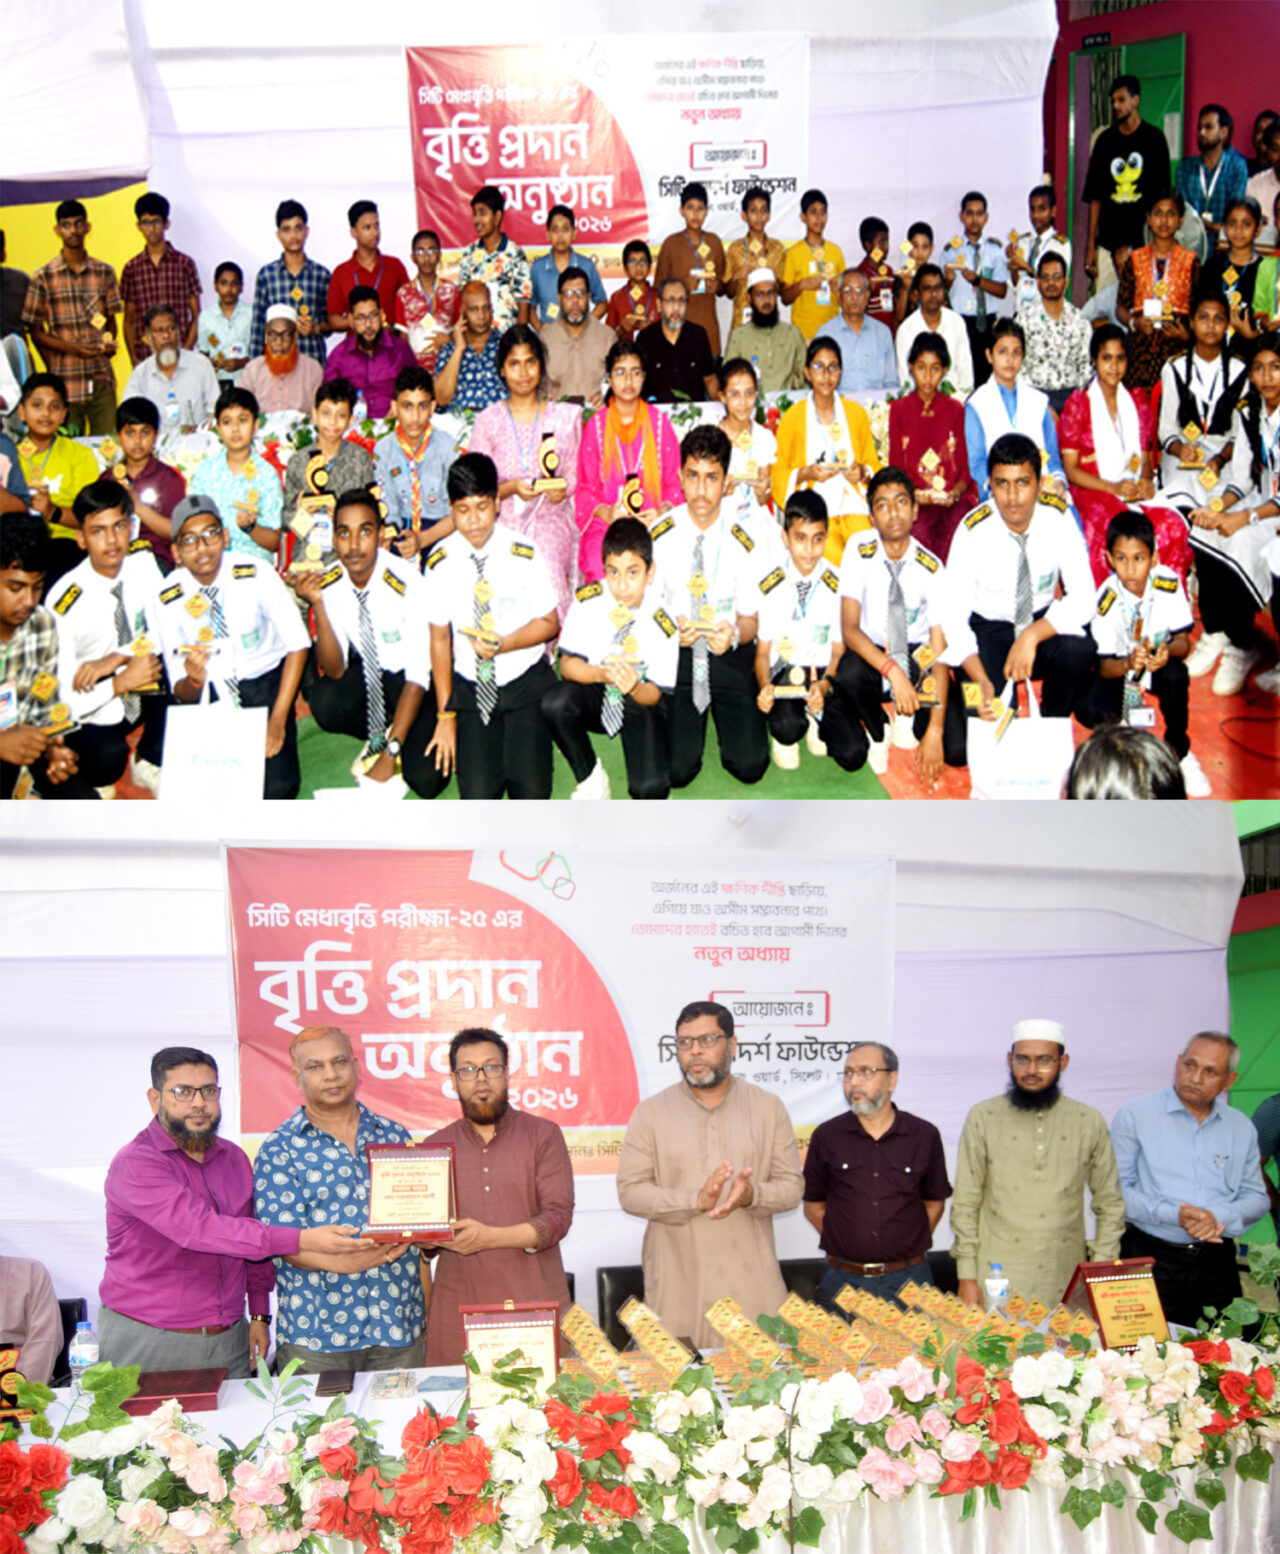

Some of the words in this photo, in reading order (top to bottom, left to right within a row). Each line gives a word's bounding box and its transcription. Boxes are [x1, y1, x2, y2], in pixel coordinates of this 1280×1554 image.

[422, 112, 490, 181] বৃত্তি
[499, 122, 589, 168] প্রদান
[574, 217, 612, 232] ০২৬
[701, 882, 718, 895] এই
[248, 903, 290, 927] সিটি
[295, 903, 377, 934] মেধাবৃত্তি
[382, 903, 487, 928] পরীক্ষা-২৫
[491, 909, 523, 929] এর
[690, 903, 712, 916] যাও
[720, 921, 750, 937] রচিত
[752, 925, 772, 937] হবে
[774, 922, 814, 937] আগামী
[816, 923, 847, 938] দিনের
[693, 946, 733, 967] নতুন
[737, 946, 791, 964] অধ্যায়
[253, 940, 372, 1035] বৃত্তি
[386, 959, 542, 1019] প্রদান
[732, 1033, 771, 1063] দর্শ
[507, 1087, 578, 1111] ২০২৬
